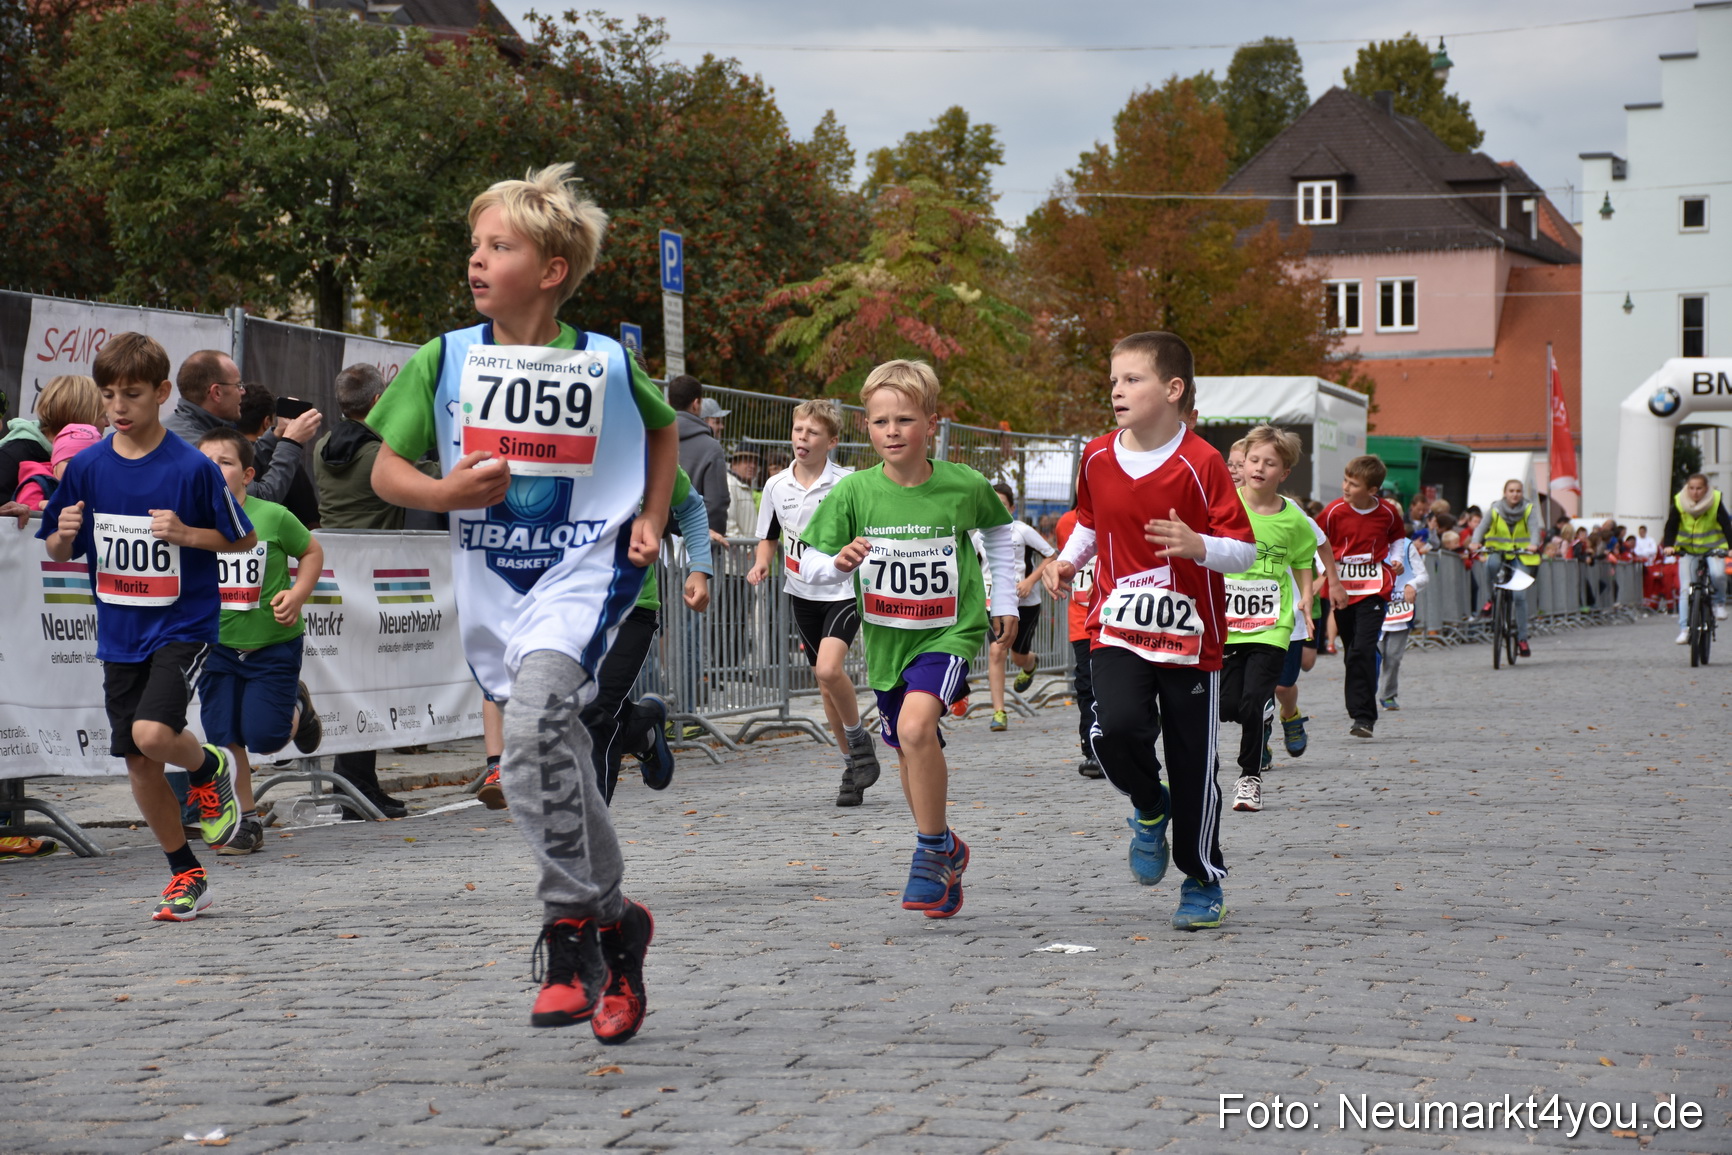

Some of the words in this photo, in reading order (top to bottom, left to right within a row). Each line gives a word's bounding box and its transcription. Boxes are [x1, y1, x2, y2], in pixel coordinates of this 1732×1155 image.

[665, 239, 678, 283] P
[468, 355, 513, 370] PARTL
[516, 359, 582, 374] Neumarkt
[1692, 371, 1732, 395] BM
[477, 374, 592, 429] 7059
[498, 436, 557, 459] Simon
[95, 522, 118, 533] PARTL
[119, 524, 152, 535] Neumar
[460, 521, 604, 551] FIBALON
[864, 524, 932, 535] Neumarkter
[103, 536, 171, 572] 7006
[788, 535, 807, 559] 70
[869, 545, 891, 556] ARTL
[893, 547, 939, 558] Neumarkt
[217, 559, 259, 584] 018
[869, 560, 949, 595] 7055
[1078, 569, 1094, 588] 71
[1130, 575, 1155, 588] DEHN
[1340, 562, 1377, 578] 7008
[114, 579, 149, 594] Moritz
[875, 599, 943, 617] Maximilian
[1115, 593, 1195, 632] 7002
[1225, 593, 1274, 615] 7065
[1387, 600, 1410, 616] 050
[41, 612, 98, 640] NeuerM
[303, 611, 344, 636] rMarkt
[378, 608, 442, 635] NeuerMarkt
